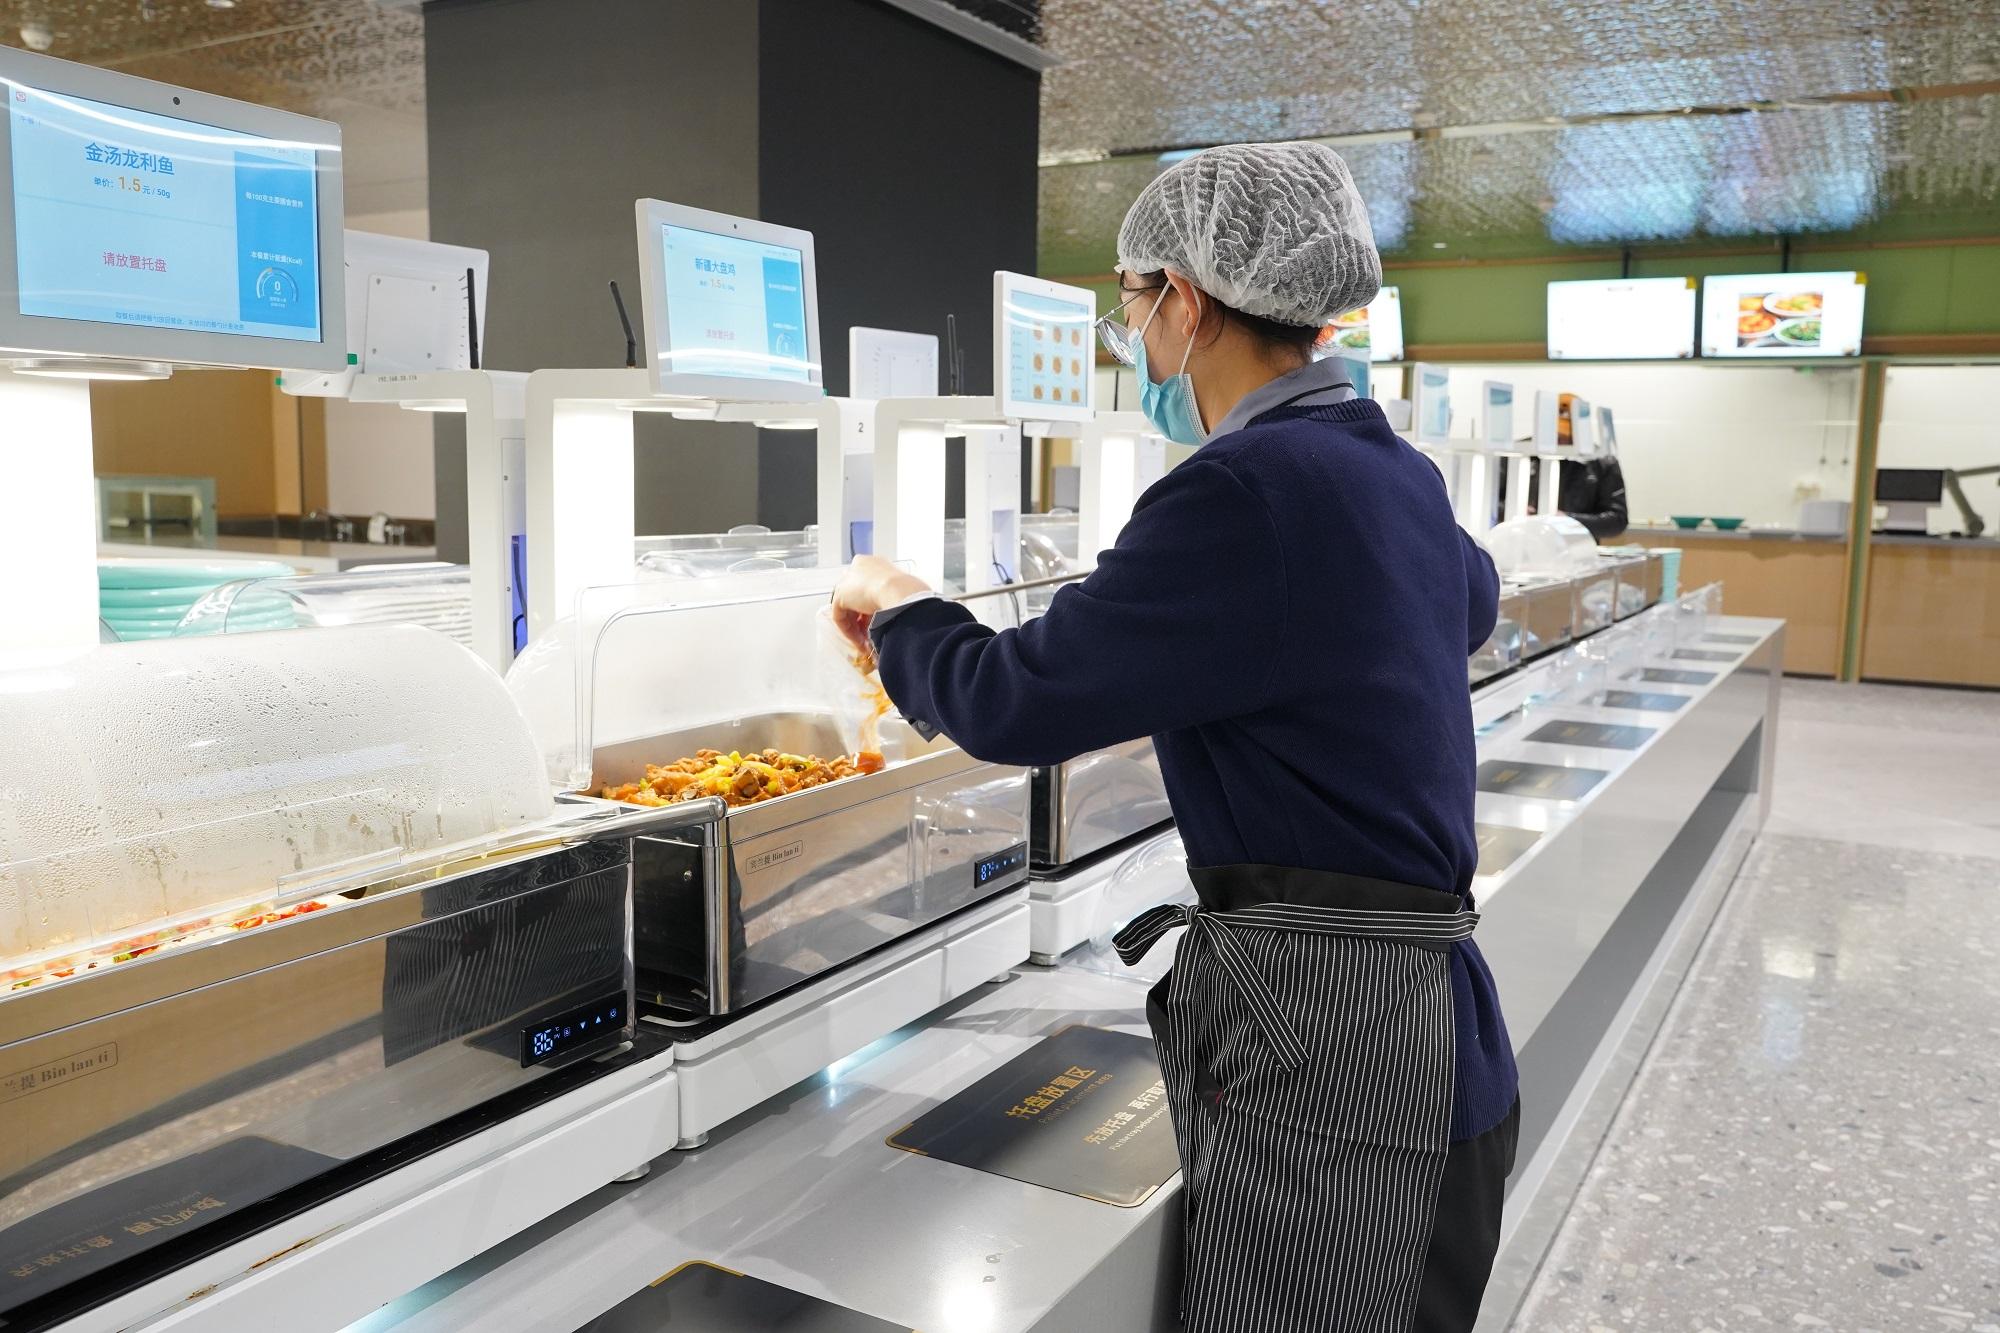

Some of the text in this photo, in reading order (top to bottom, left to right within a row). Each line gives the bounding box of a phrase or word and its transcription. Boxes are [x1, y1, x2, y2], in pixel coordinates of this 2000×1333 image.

[85, 142, 175, 175] 金汤龙利鱼
[119, 176, 141, 192] 1.5
[103, 252, 167, 272] 请放置托盘
[695, 258, 736, 275] 新疆大盘鸡
[858, 422, 864, 432] 2
[981, 863, 991, 881] 87
[534, 1029, 553, 1055] 86
[41, 1067, 66, 1082] Bin
[71, 1058, 94, 1073] lan
[1005, 1066, 1097, 1120] 托盘放置区
[1083, 1111, 1137, 1144] 先放托盘
